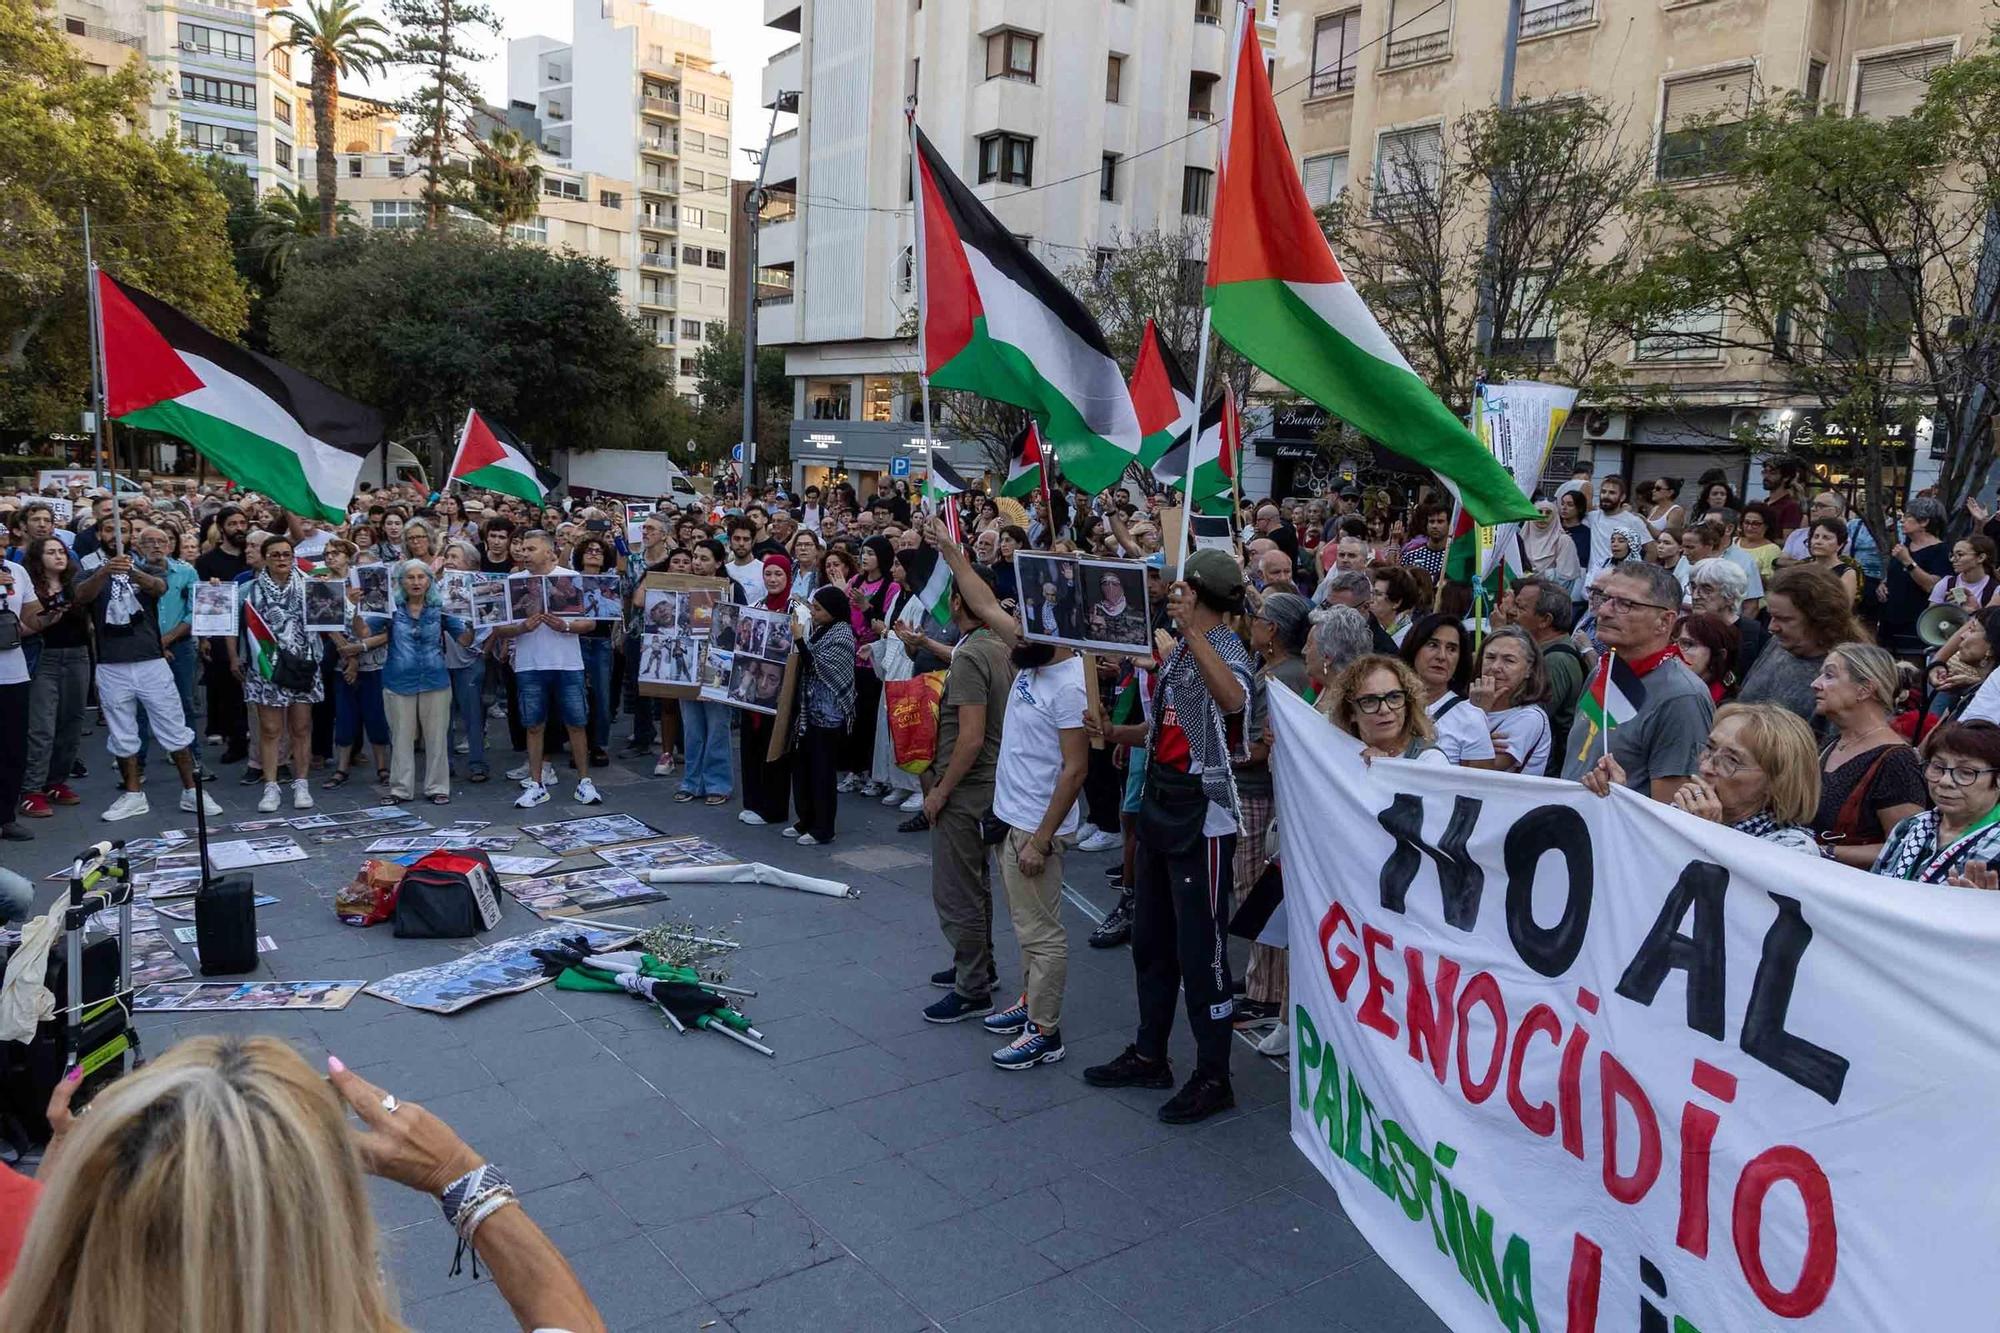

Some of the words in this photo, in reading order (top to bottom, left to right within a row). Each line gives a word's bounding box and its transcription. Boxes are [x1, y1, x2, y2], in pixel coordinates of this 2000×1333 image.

[895, 459, 906, 474] P
[1378, 793, 1594, 978] NO
[1614, 859, 1851, 1106] AL
[1296, 1004, 1541, 1333] PALESTINA
